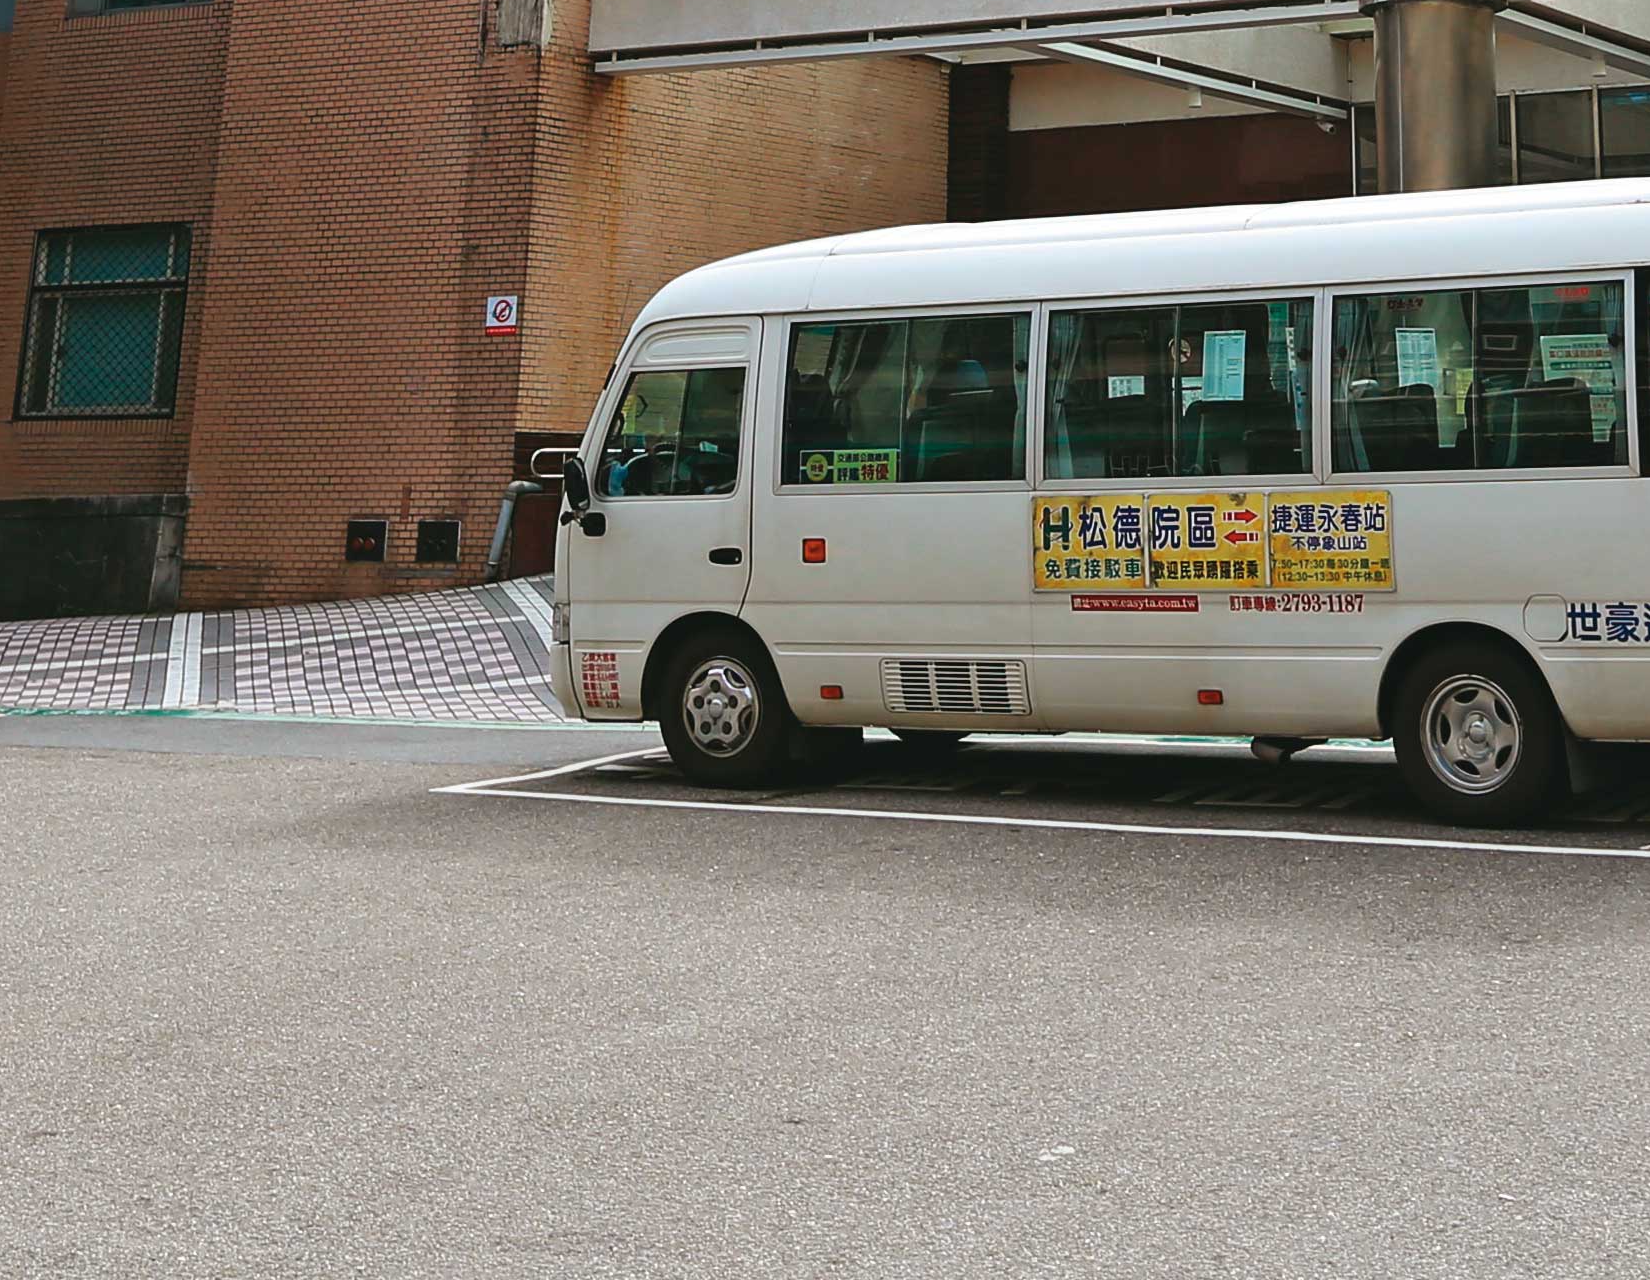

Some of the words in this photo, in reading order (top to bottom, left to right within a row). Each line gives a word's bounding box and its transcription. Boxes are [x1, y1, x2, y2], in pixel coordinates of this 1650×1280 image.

[1271, 503, 1386, 533] 捷運永春站
[1291, 535, 1367, 551] 不停象山站
[1045, 557, 1142, 580] 免費接駁車
